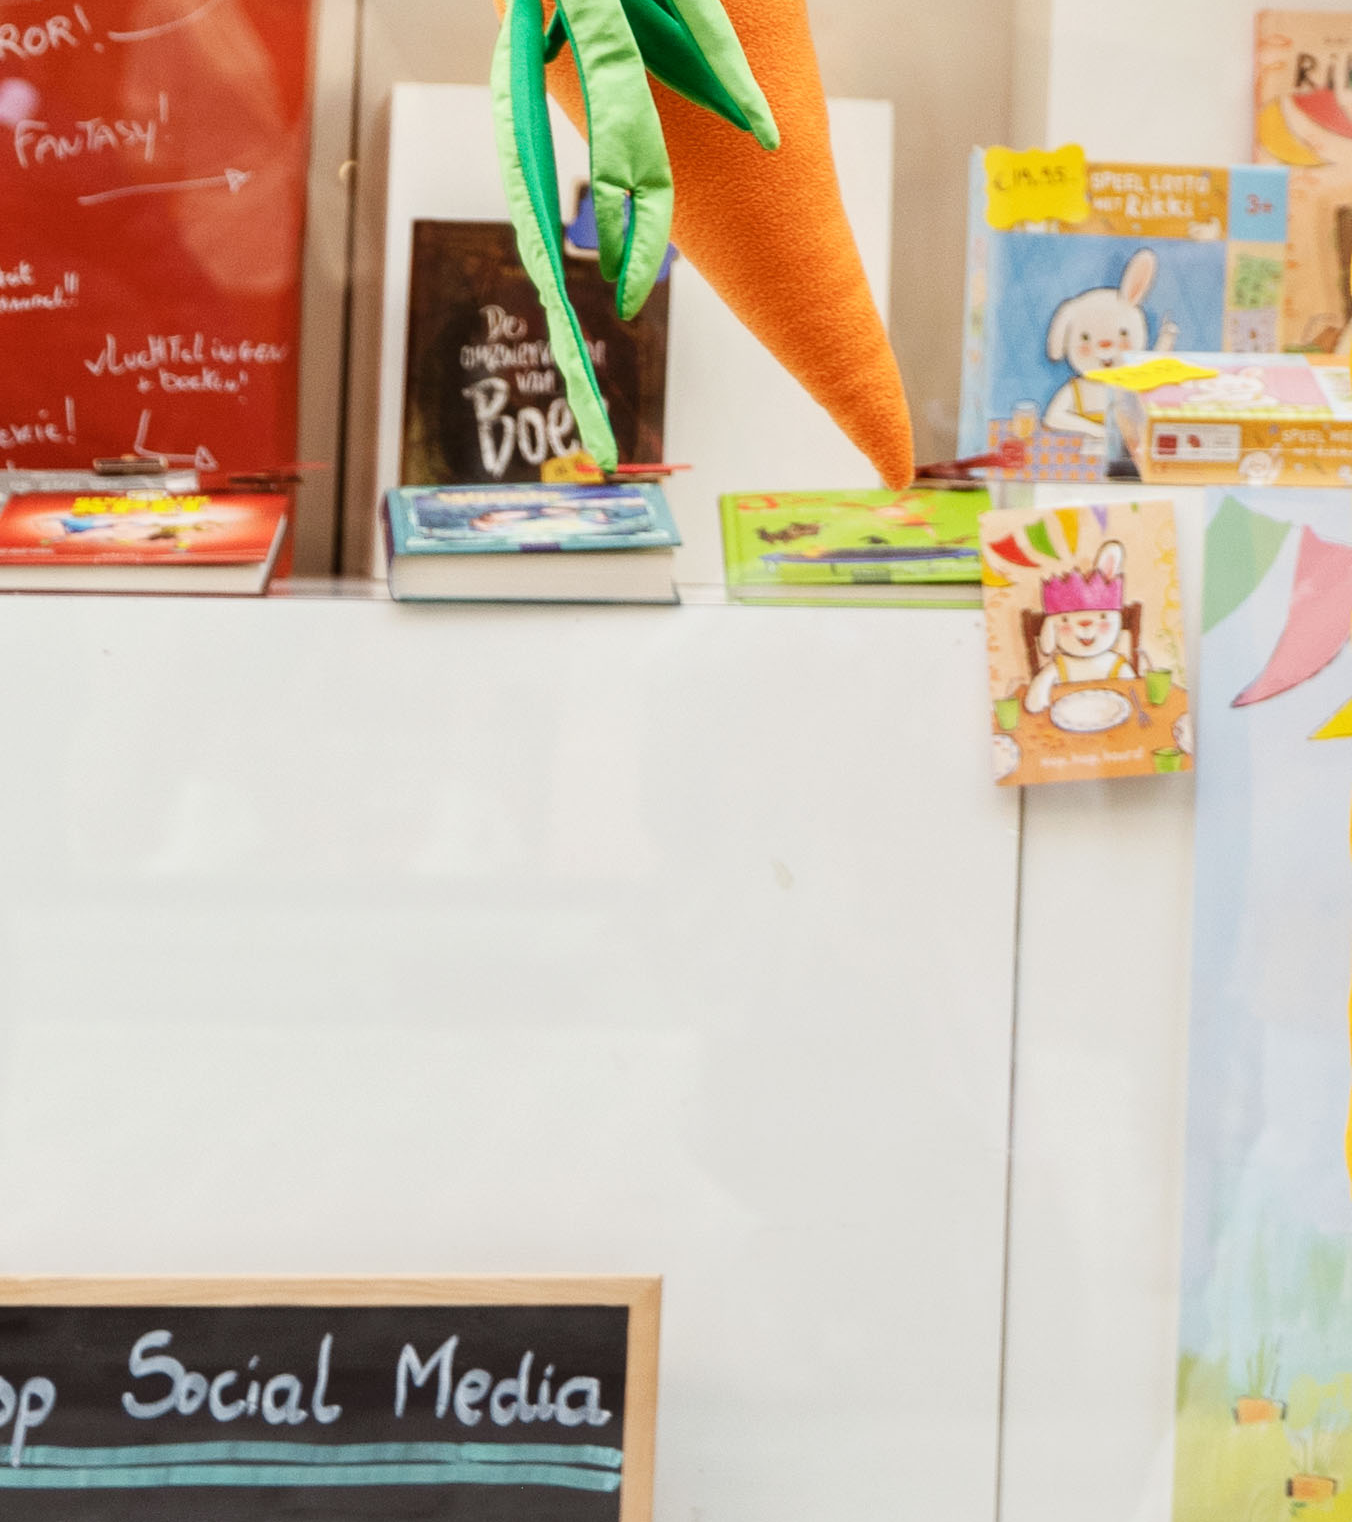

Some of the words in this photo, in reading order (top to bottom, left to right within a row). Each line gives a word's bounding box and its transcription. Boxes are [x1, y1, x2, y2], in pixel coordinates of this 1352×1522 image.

[1090, 171, 1145, 193] SPEEL
[462, 376, 610, 482] Boe
[121, 1328, 343, 1425] Social
[395, 1334, 612, 1426] Media
